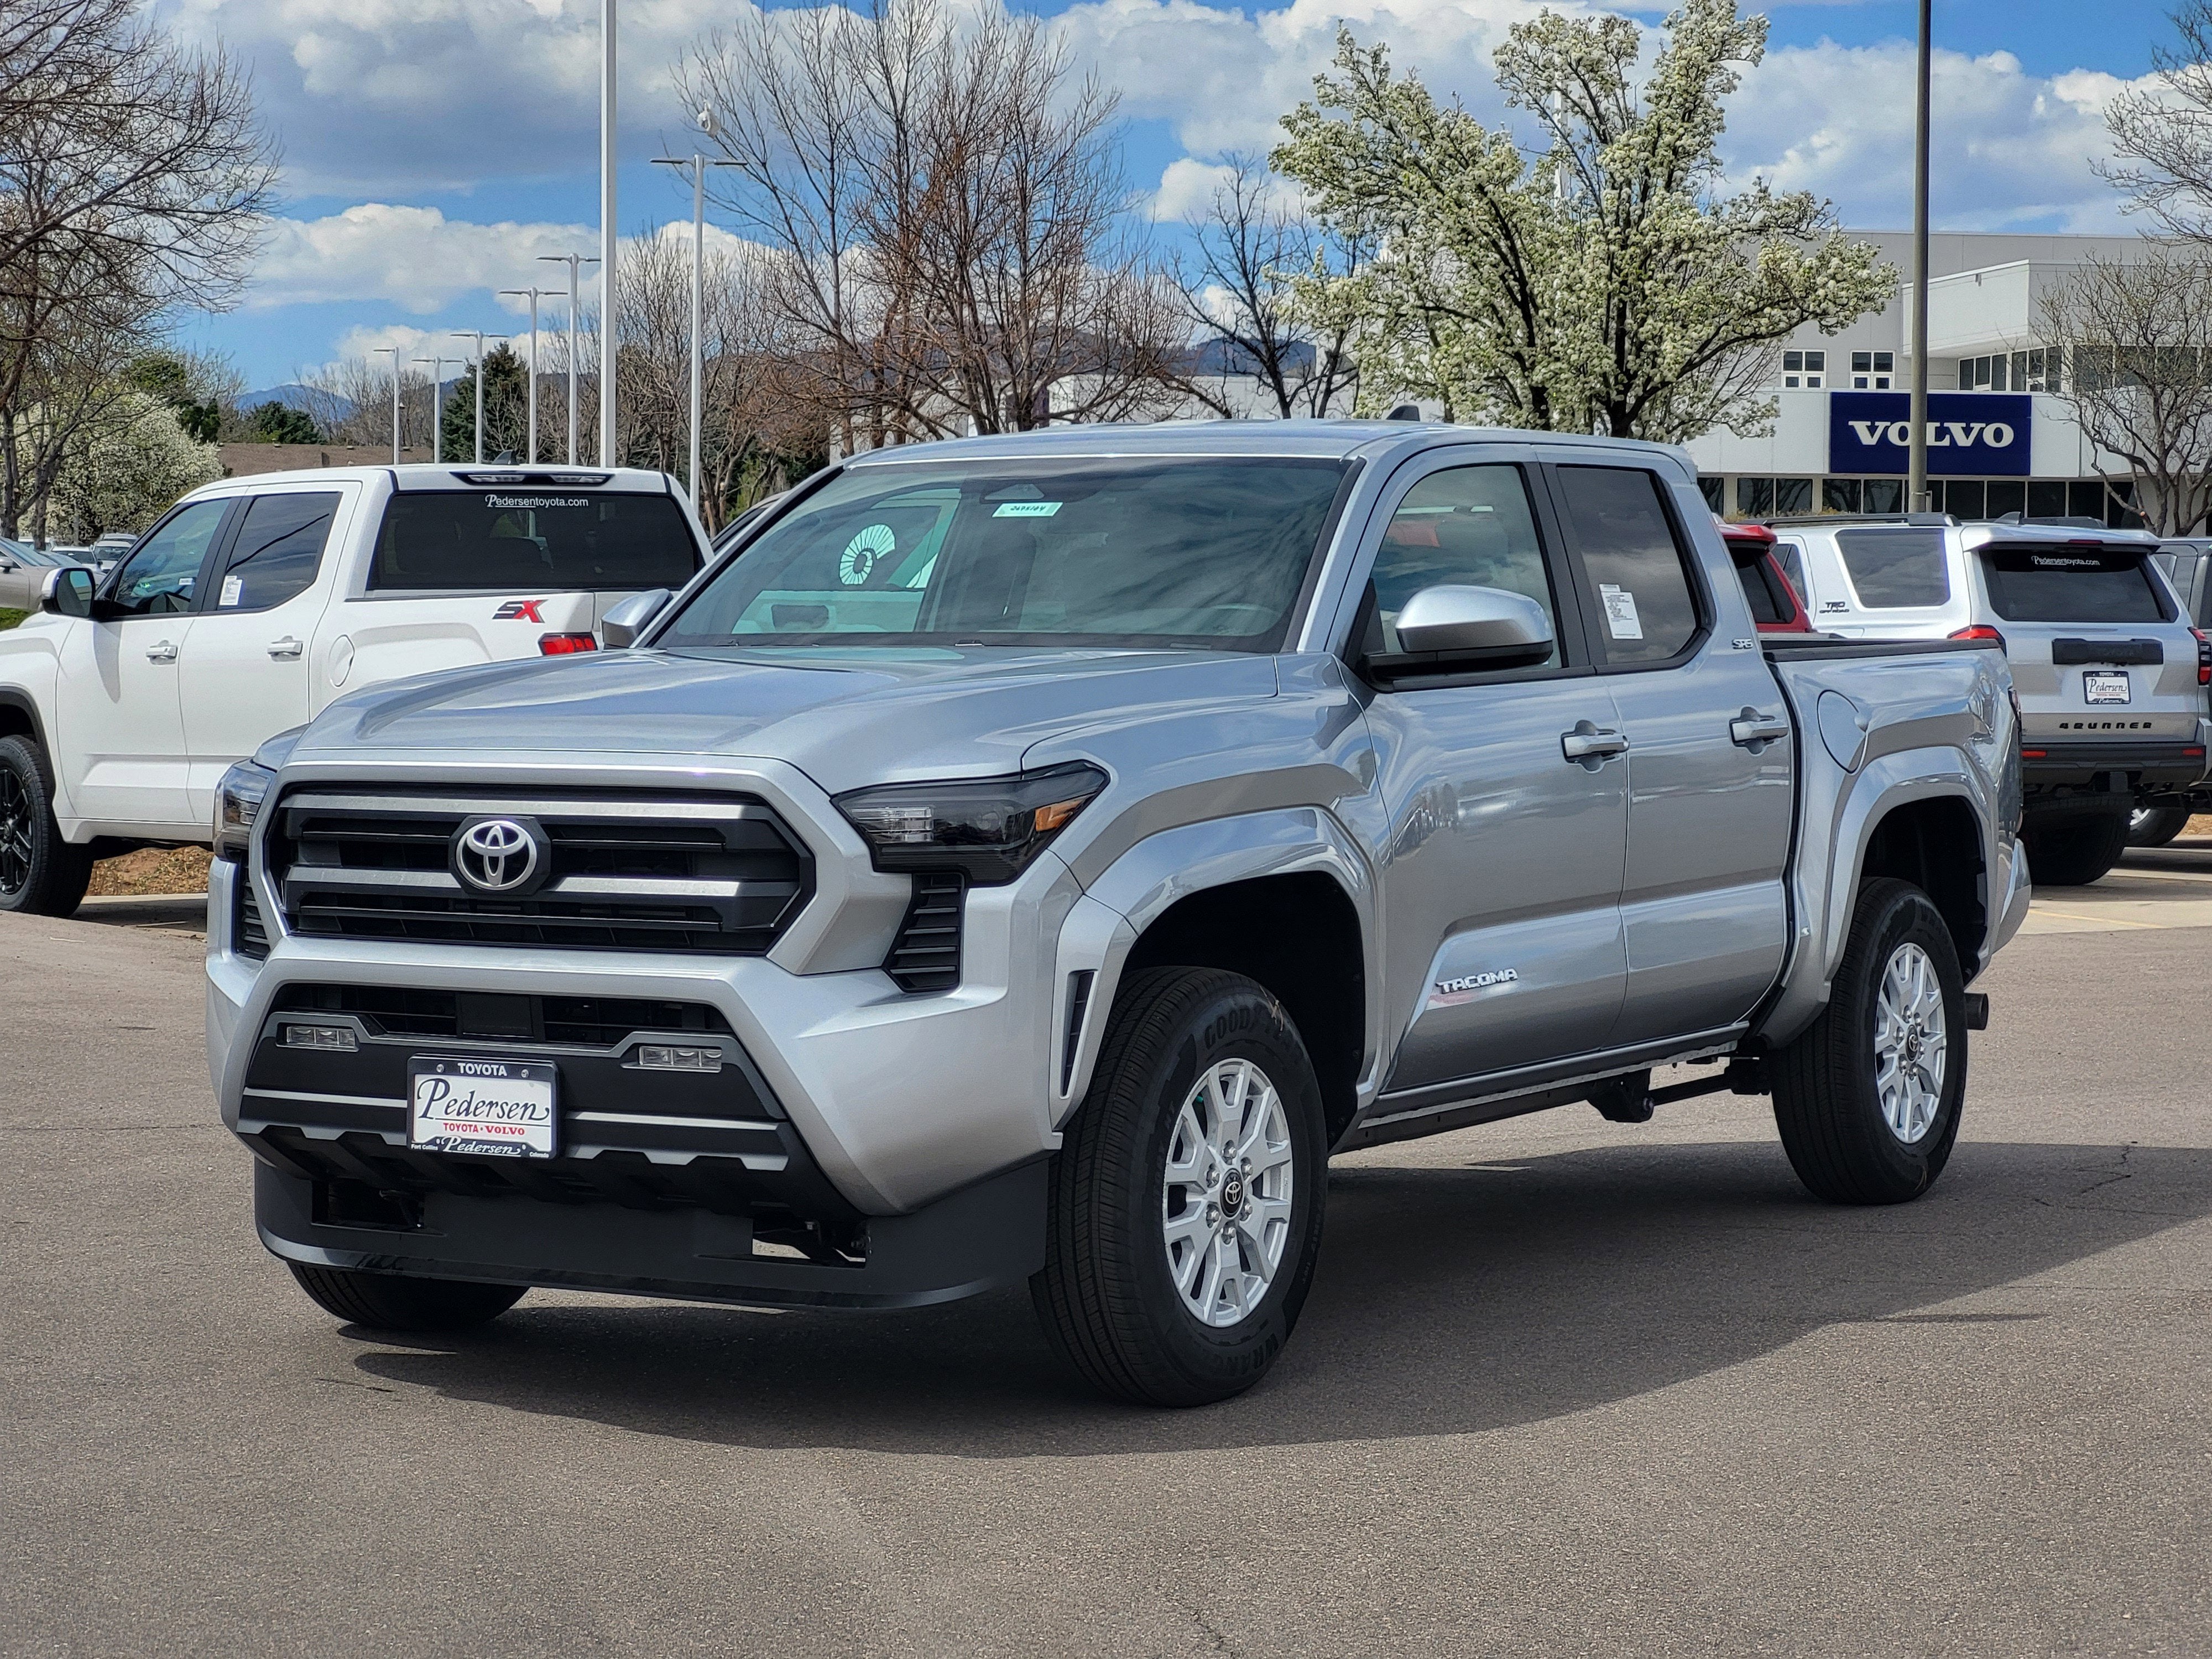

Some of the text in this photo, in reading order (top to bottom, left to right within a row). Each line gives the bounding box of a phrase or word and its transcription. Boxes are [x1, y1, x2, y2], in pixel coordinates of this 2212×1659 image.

[1848, 421, 2015, 447] VOLVO
[485, 494, 589, 508] Pedersentoyota.com
[2087, 678, 2127, 693] Pedersen
[1436, 968, 1519, 994] TACOMA
[457, 1062, 508, 1077] TOYOTA
[417, 1078, 550, 1121] Pedersen
[443, 1123, 525, 1135] TOYOTA VOLVO
[441, 1135, 521, 1155] Pedersen
